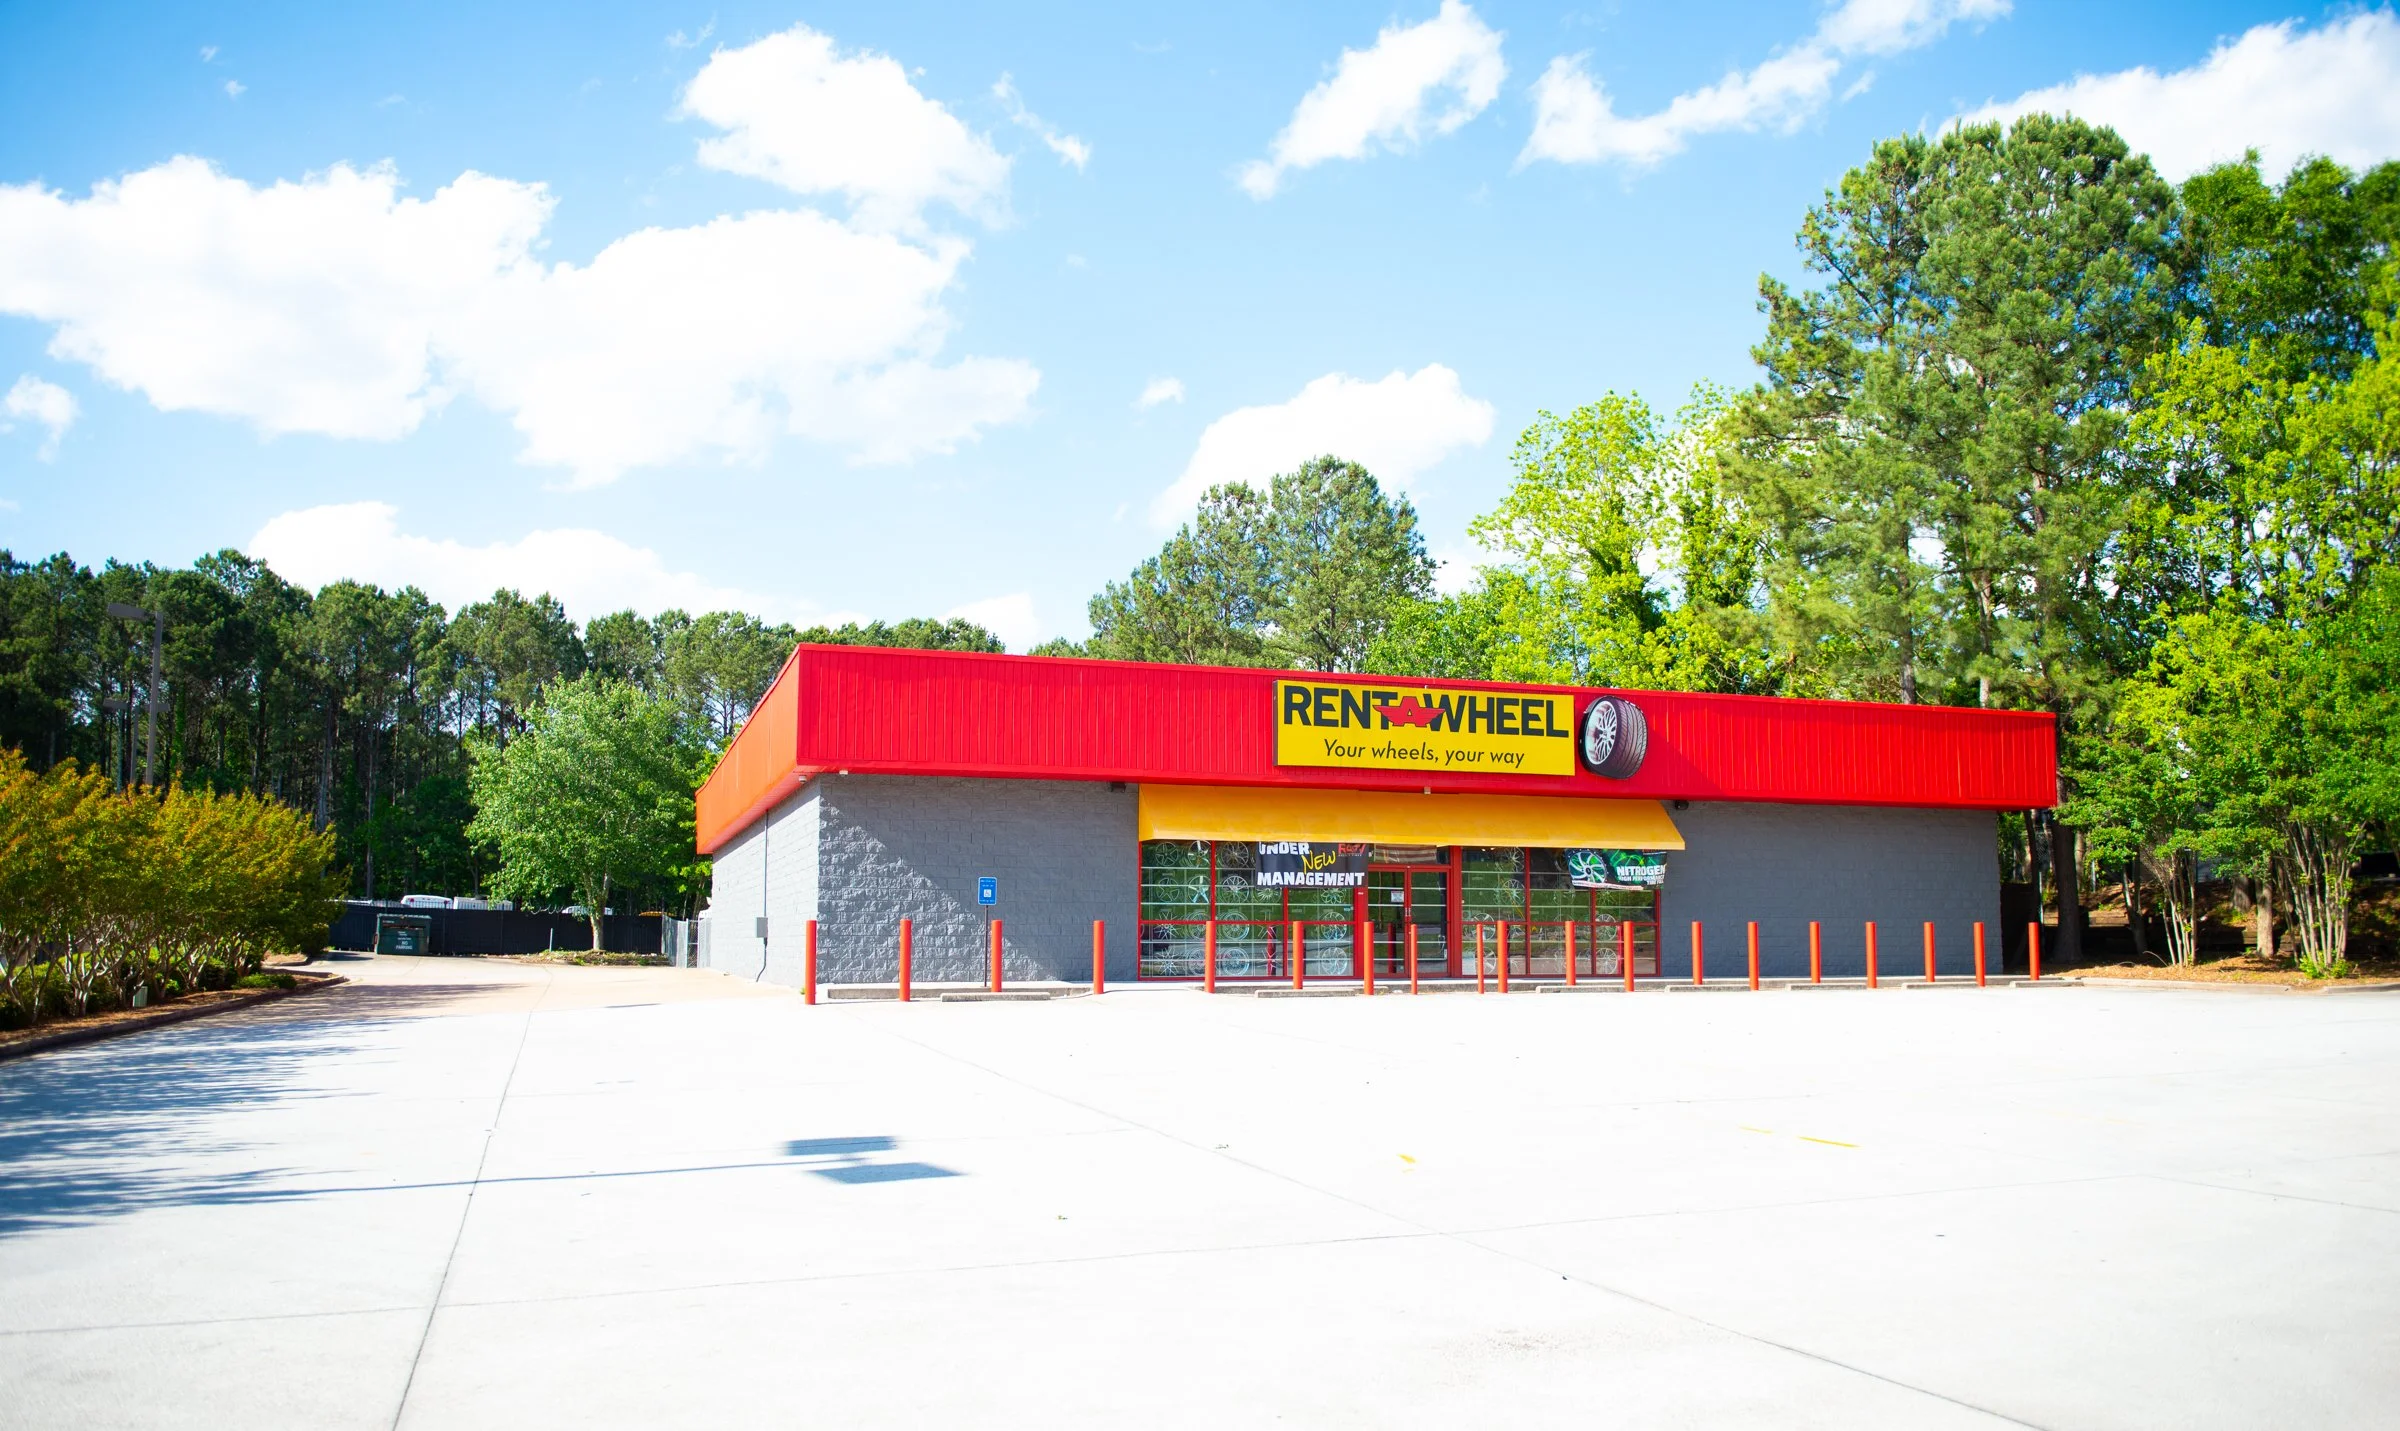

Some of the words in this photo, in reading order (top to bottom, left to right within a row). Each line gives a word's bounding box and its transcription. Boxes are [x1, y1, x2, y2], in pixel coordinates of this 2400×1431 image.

[1284, 685, 1398, 730] RENT
[1422, 693, 1569, 738] WHEEL
[1324, 738, 1365, 758] Your
[1371, 740, 1439, 762] wheels,
[1445, 749, 1484, 766] your
[1490, 751, 1525, 768] way
[1258, 841, 1310, 855] UNDER
[1301, 850, 1336, 875] NEW
[1616, 865, 1666, 876] NITROGEN
[1257, 871, 1365, 886] MANAGEMENT
